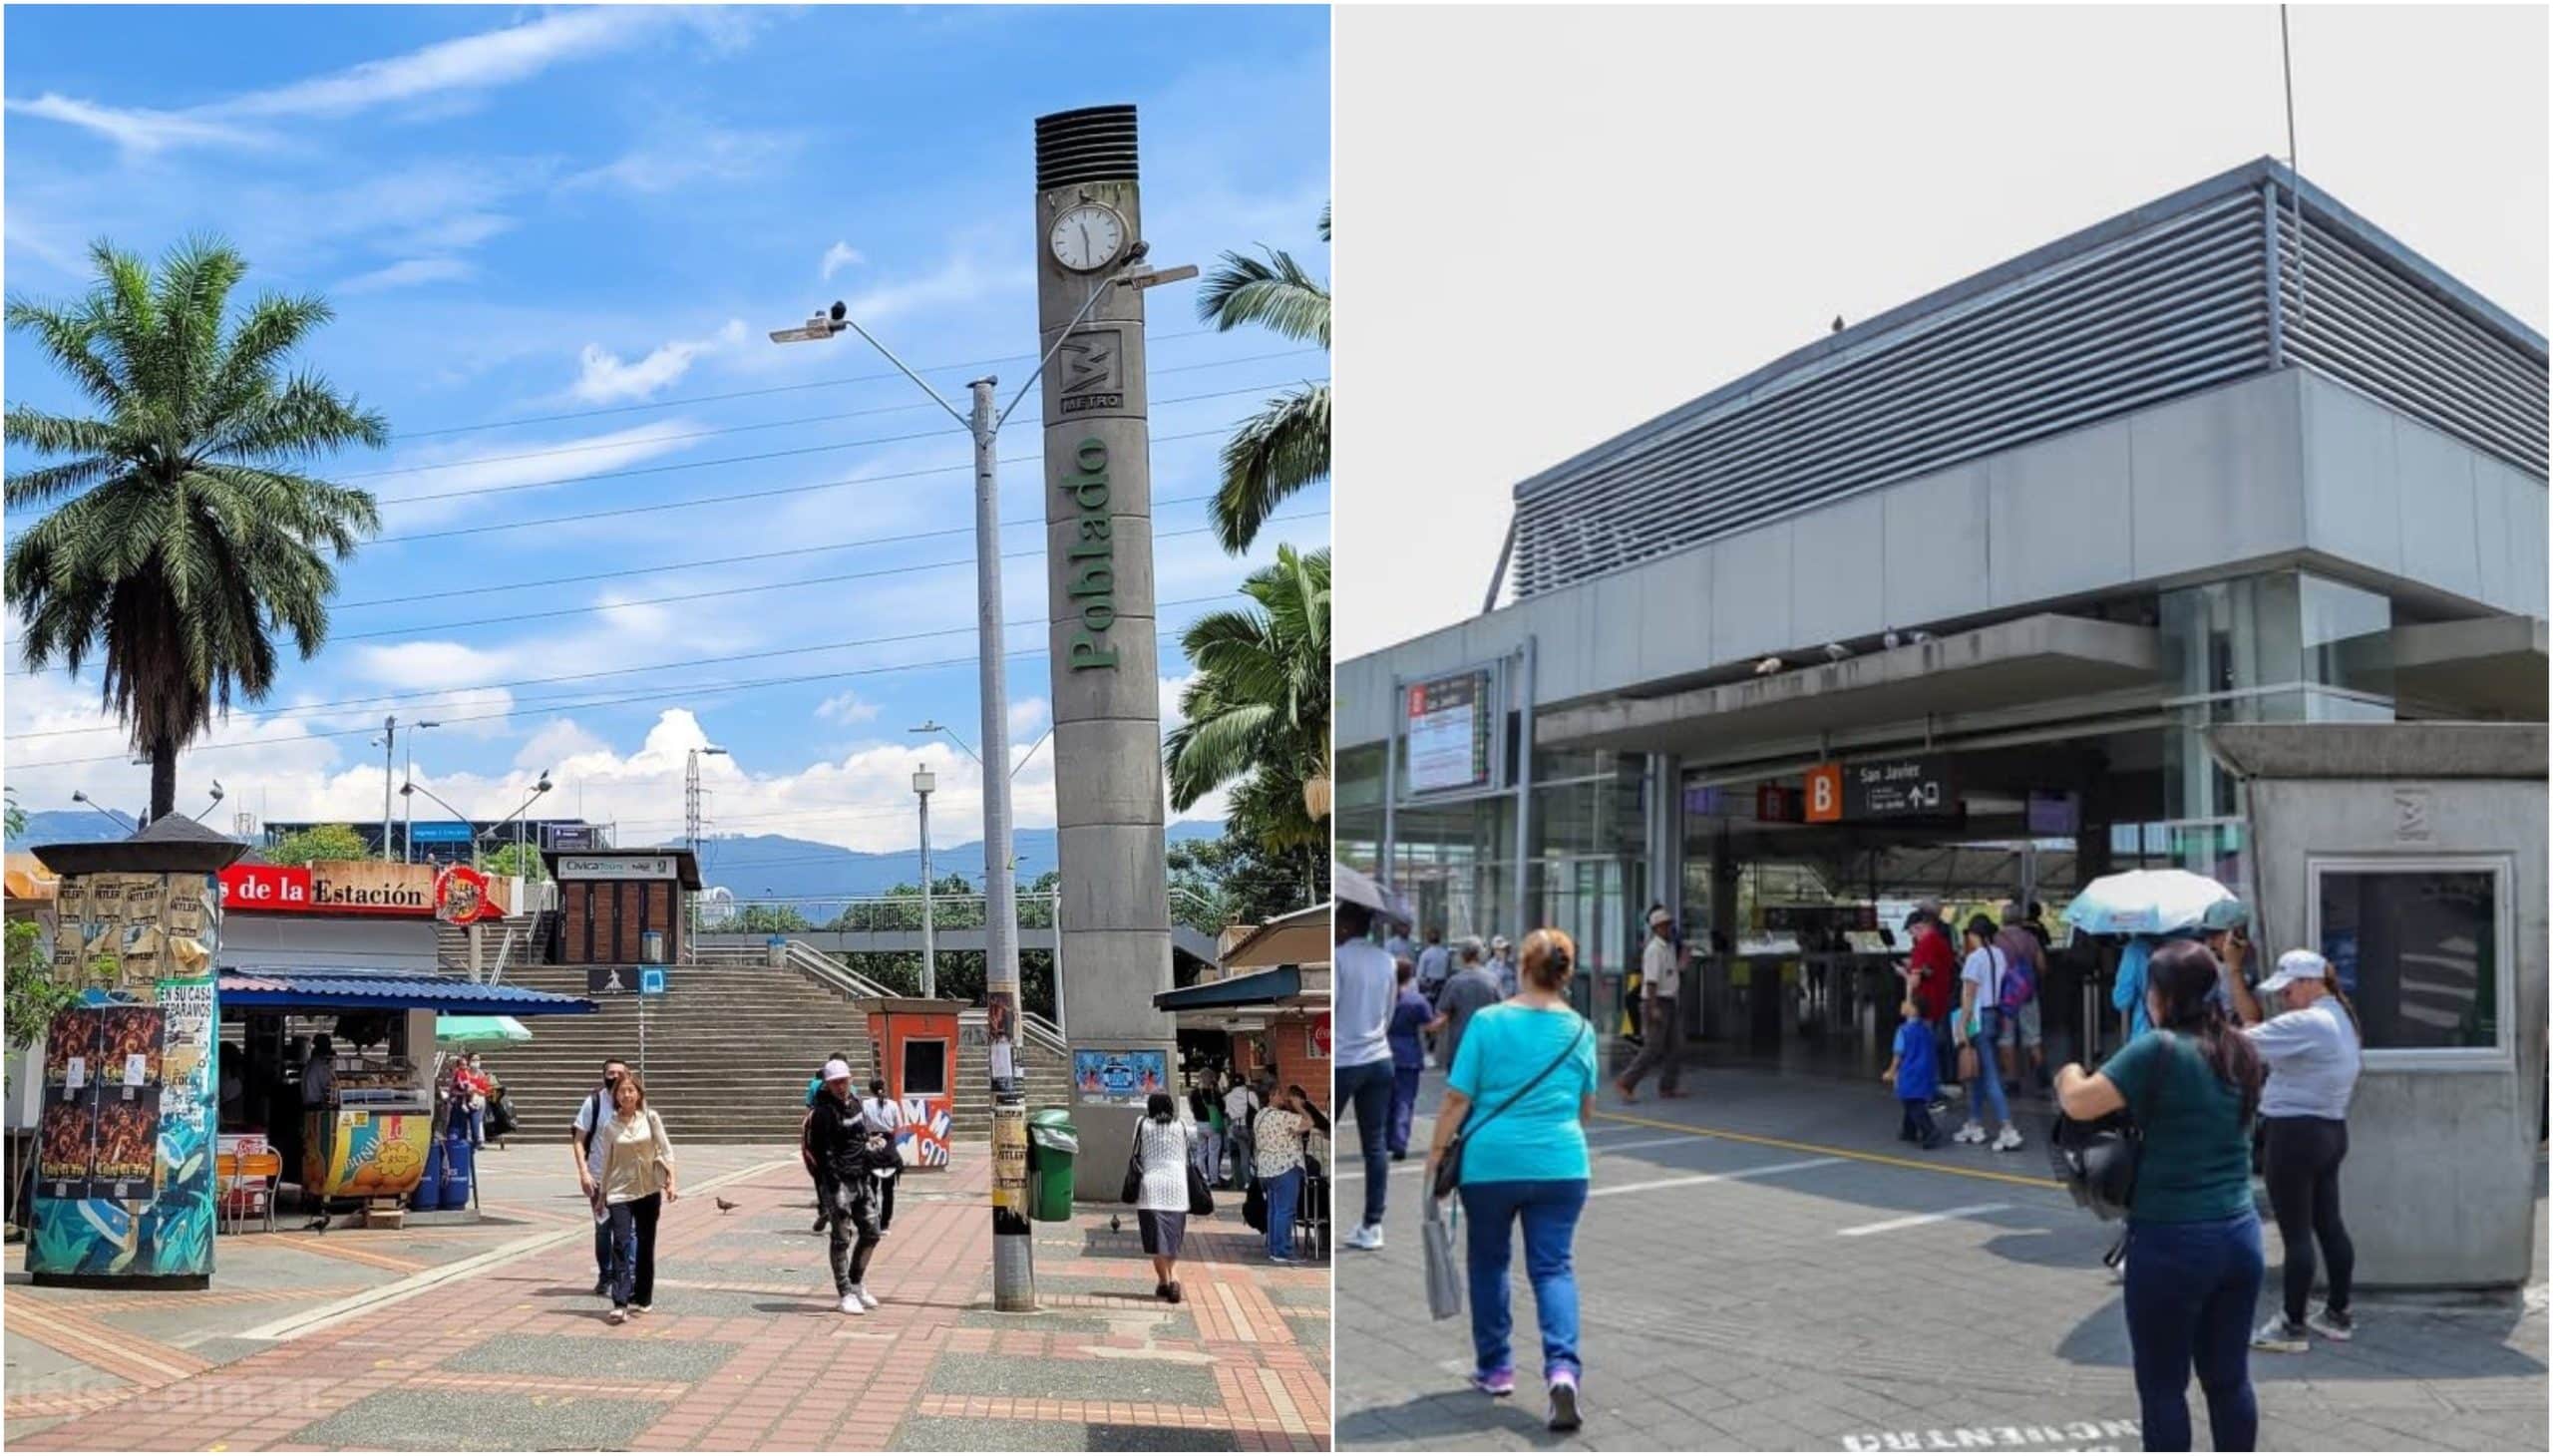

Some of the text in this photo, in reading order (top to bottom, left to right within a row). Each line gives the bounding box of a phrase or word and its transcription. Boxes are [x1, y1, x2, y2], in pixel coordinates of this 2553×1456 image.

[1063, 396, 1118, 412] METRO
[1057, 437, 1119, 671] Poblado
[1860, 762, 1922, 784] San Javier
[1814, 776, 1833, 813] B
[239, 875, 270, 901] de
[280, 877, 304, 902] la
[313, 879, 423, 906] Estación
[160, 986, 212, 1002] EN SU CASA
